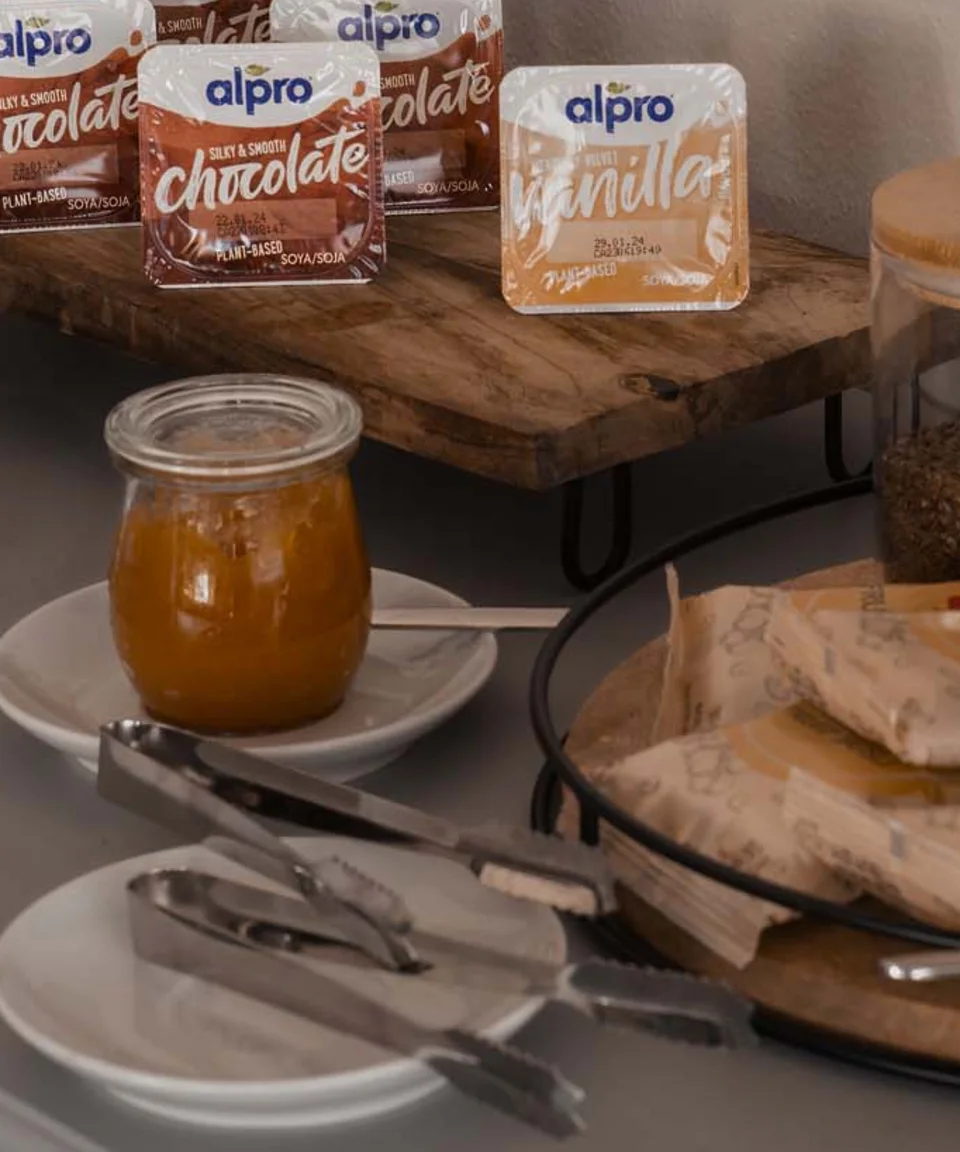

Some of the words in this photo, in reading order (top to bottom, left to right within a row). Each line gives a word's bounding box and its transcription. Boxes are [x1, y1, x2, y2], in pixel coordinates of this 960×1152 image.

[167, 17, 203, 33] SMOOTH
[338, 3, 441, 50] alpro
[20, 94, 29, 108] &
[30, 88, 67, 106] SMOOTH
[205, 67, 314, 115] alpro
[565, 83, 674, 134] alpro
[2, 74, 139, 154] ocolate
[209, 145, 236, 161] SILKY
[238, 144, 247, 157] &
[248, 139, 287, 156] SMOOTH
[154, 125, 369, 214] chocolate
[417, 180, 481, 195] SOYA/SOJA
[510, 139, 713, 230] vanilla
[2, 187, 67, 210] PLANT-BASED
[67, 195, 130, 211] SOYA/SOJA
[216, 240, 283, 262] PLANT-BASED
[281, 252, 346, 266] SOYA/SOJA
